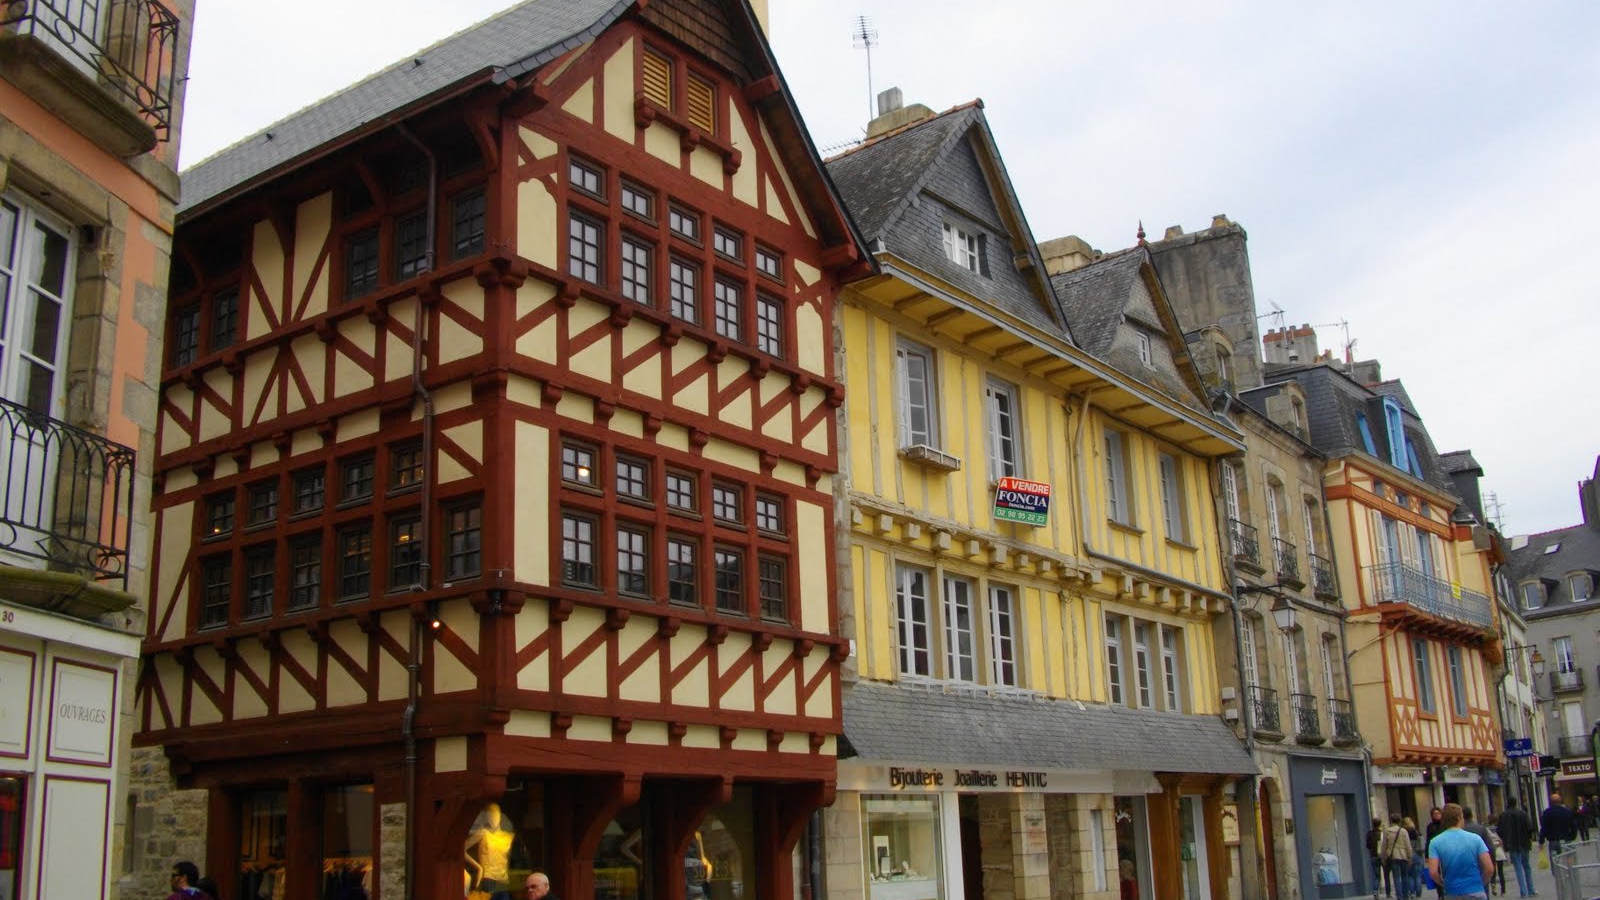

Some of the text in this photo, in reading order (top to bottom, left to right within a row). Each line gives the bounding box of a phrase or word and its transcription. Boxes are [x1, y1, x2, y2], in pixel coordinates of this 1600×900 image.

[1001, 479, 1049, 494] A VENDRE
[999, 490, 1047, 507] FONCIA
[997, 508, 1005, 516] 02
[1009, 502, 1035, 510] foncia.com
[2, 610, 14, 623] 30
[60, 703, 106, 723] OUVRAGES
[1568, 764, 1591, 772] TEXTO
[890, 767, 1047, 789] Bijouterie Joaillerie HENTIC
